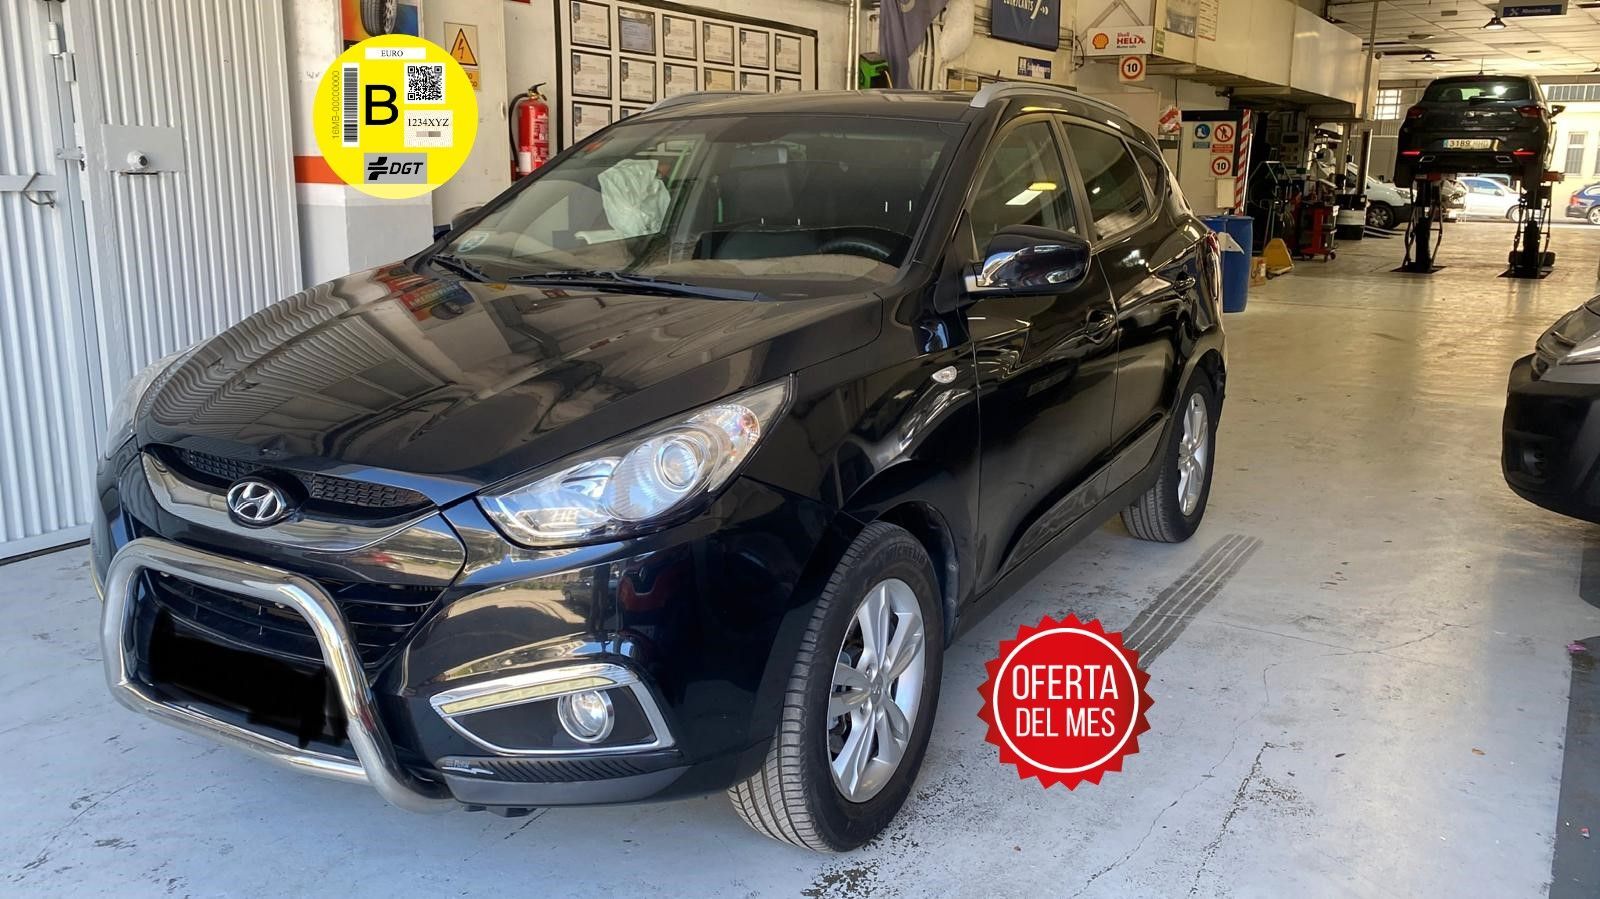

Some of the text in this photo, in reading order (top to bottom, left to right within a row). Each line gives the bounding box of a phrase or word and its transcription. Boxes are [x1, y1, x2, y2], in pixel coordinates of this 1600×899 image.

[1117, 36, 1145, 44] HELIX
[1126, 63, 1138, 72] 10
[1216, 162, 1227, 170] 10
